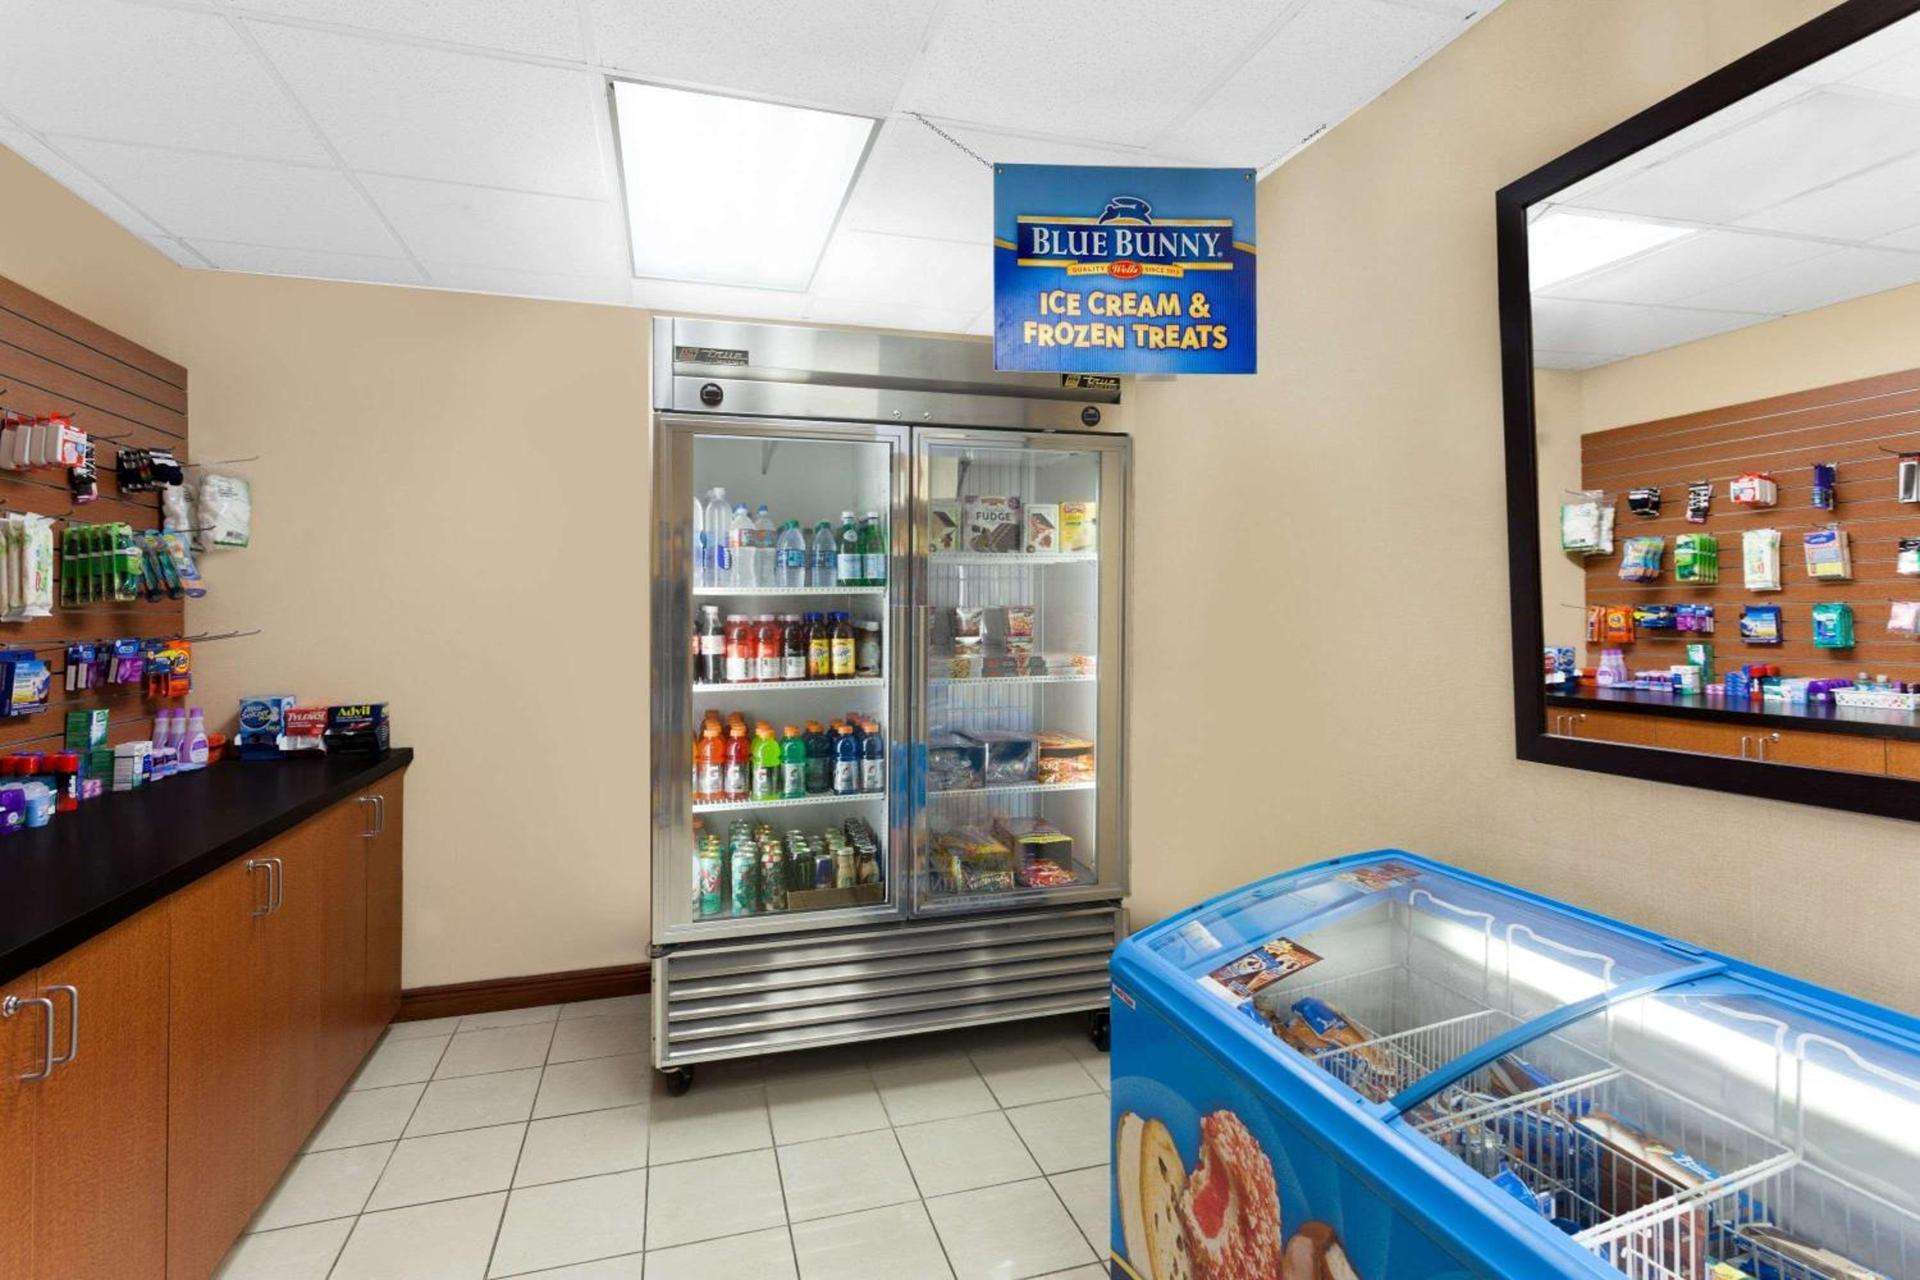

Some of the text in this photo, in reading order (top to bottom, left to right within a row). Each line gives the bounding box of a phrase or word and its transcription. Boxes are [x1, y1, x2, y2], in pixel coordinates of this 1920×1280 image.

[1032, 226, 1221, 257] BLUE BUNNY
[1071, 265, 1106, 273] QUALITY
[1111, 262, 1139, 273] Wells
[1145, 266, 1164, 274] SINCE
[1039, 289, 1212, 319] ICE CREAM &
[1023, 319, 1229, 350] FROZEN TREATS
[976, 511, 1013, 522] FUDGE
[337, 705, 371, 717] Advil
